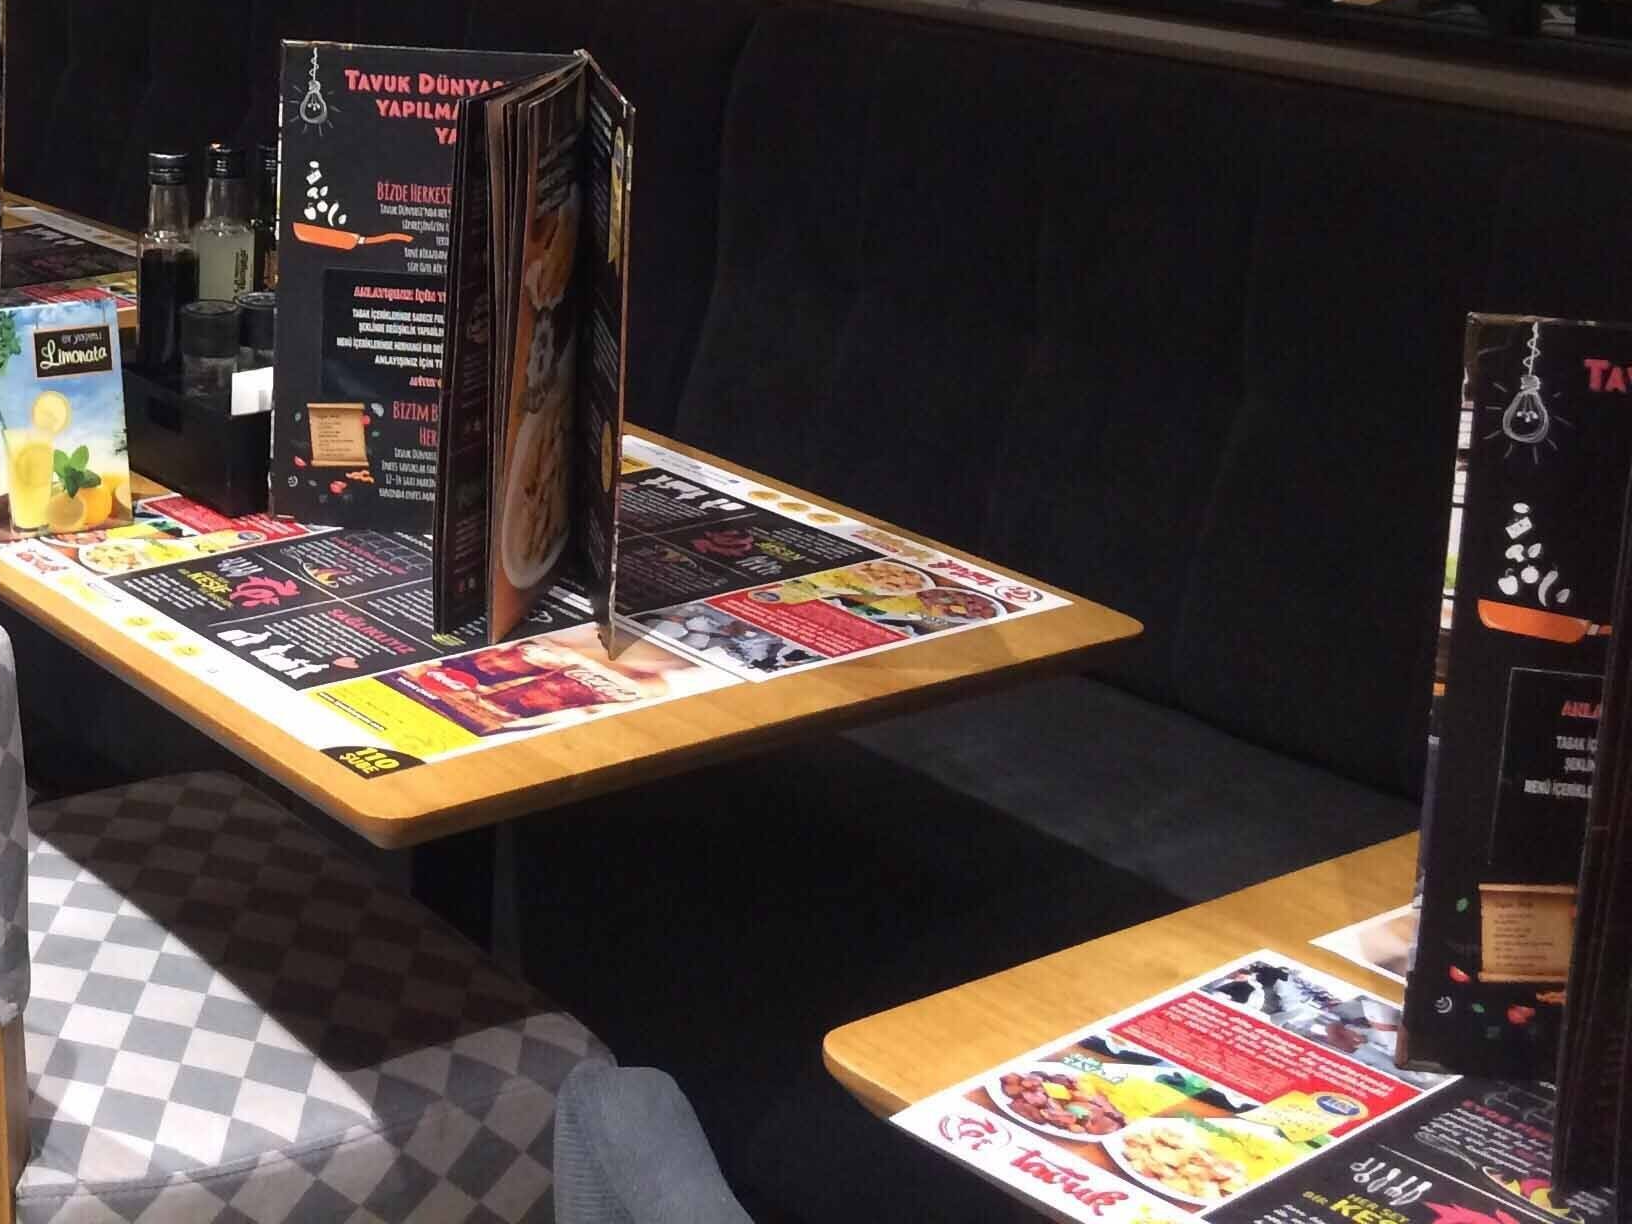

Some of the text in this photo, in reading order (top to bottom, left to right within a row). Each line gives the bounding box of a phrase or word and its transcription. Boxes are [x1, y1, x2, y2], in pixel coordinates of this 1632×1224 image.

[344, 69, 412, 94] TAVUK
[39, 339, 108, 370] Limonata
[1584, 359, 1632, 392] TA
